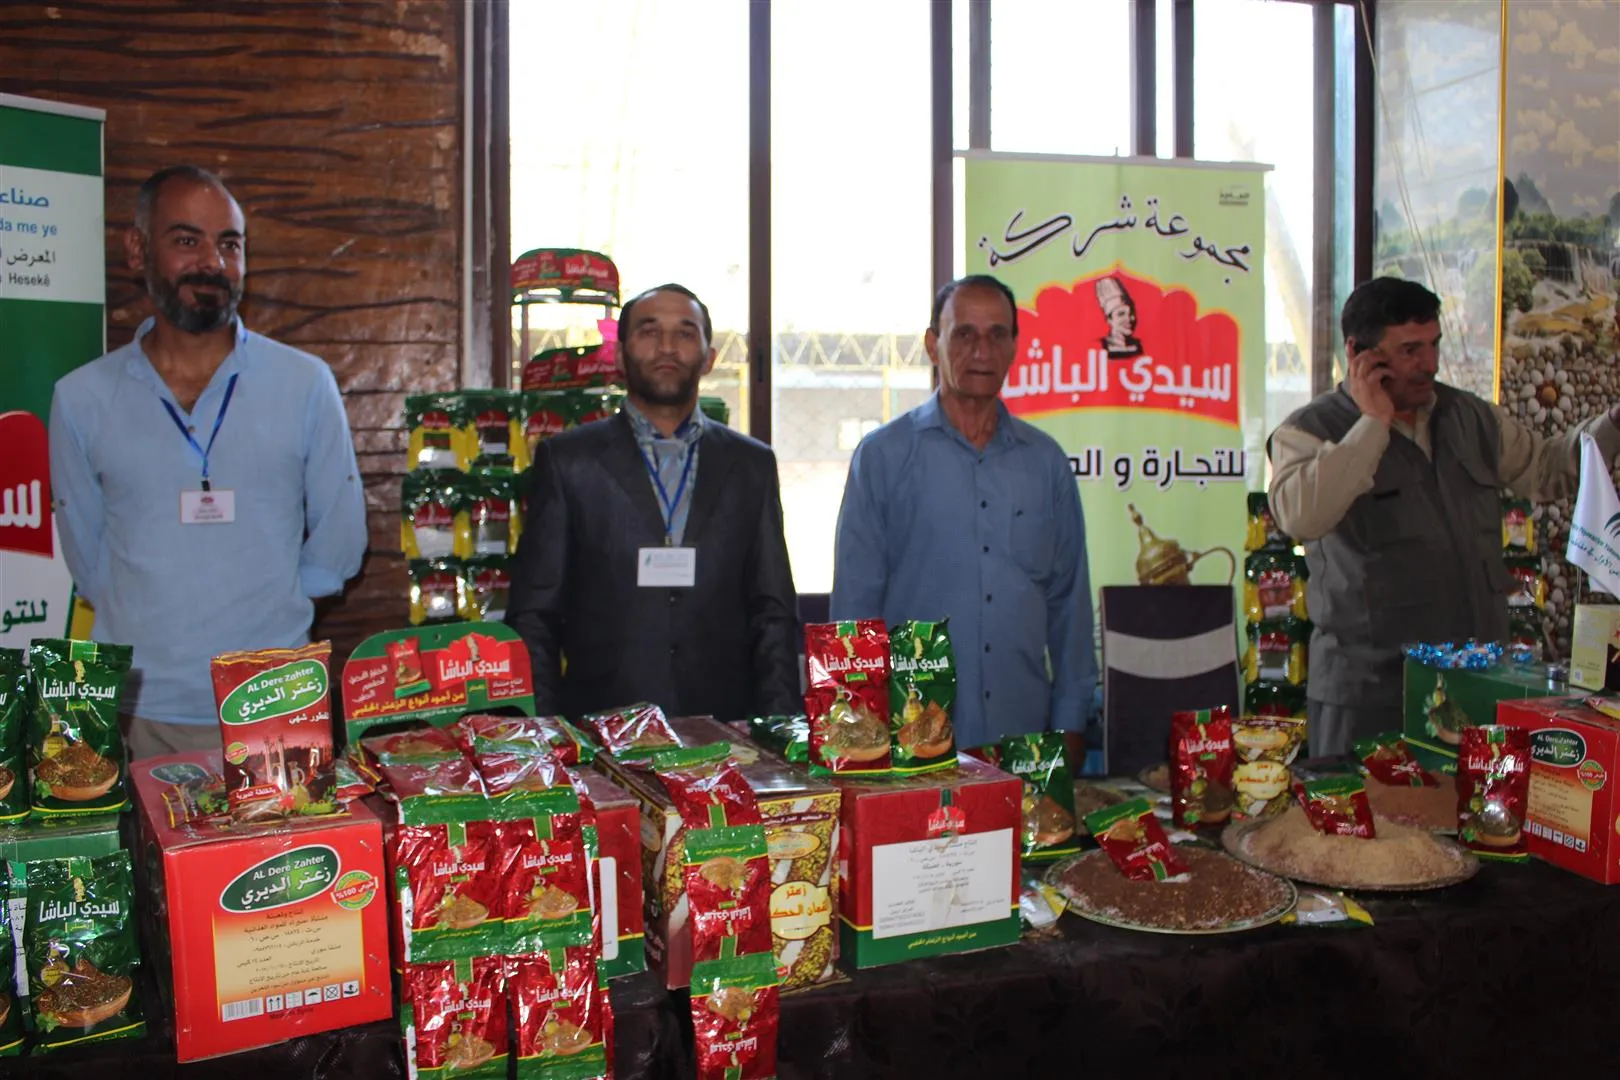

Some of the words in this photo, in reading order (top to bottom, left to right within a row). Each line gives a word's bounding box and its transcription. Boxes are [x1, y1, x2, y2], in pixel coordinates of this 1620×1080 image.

[17, 222, 37, 234] me
[42, 224, 57, 238] ye
[978, 195, 1137, 267] شركة
[6, 250, 56, 268] المعرض
[1001, 338, 1108, 403] الباش
[1119, 354, 1231, 407] سيدي
[1114, 456, 1131, 489] و
[1143, 448, 1245, 487] للتجارة
[440, 660, 473, 681] الباشا
[475, 659, 510, 677] سيدي
[823, 654, 851, 672] الباشا
[853, 656, 884, 671] سيدي
[892, 654, 918, 672] الباشا
[919, 656, 949, 672] سيدي
[42, 678, 76, 700] الباشا
[79, 684, 116, 699] سيدي
[247, 682, 260, 694] AL
[261, 677, 283, 690] Dere
[285, 667, 315, 682] Zahter
[291, 678, 322, 700] زعتر
[239, 686, 286, 721] الديري
[253, 870, 266, 881] AL
[268, 863, 291, 876] Dere
[294, 854, 326, 869] Zahter
[297, 866, 332, 890] زعتر
[240, 876, 292, 910] الديري
[785, 884, 807, 899] زعتر
[39, 900, 77, 922] الباشا
[80, 900, 120, 918] سيدي
